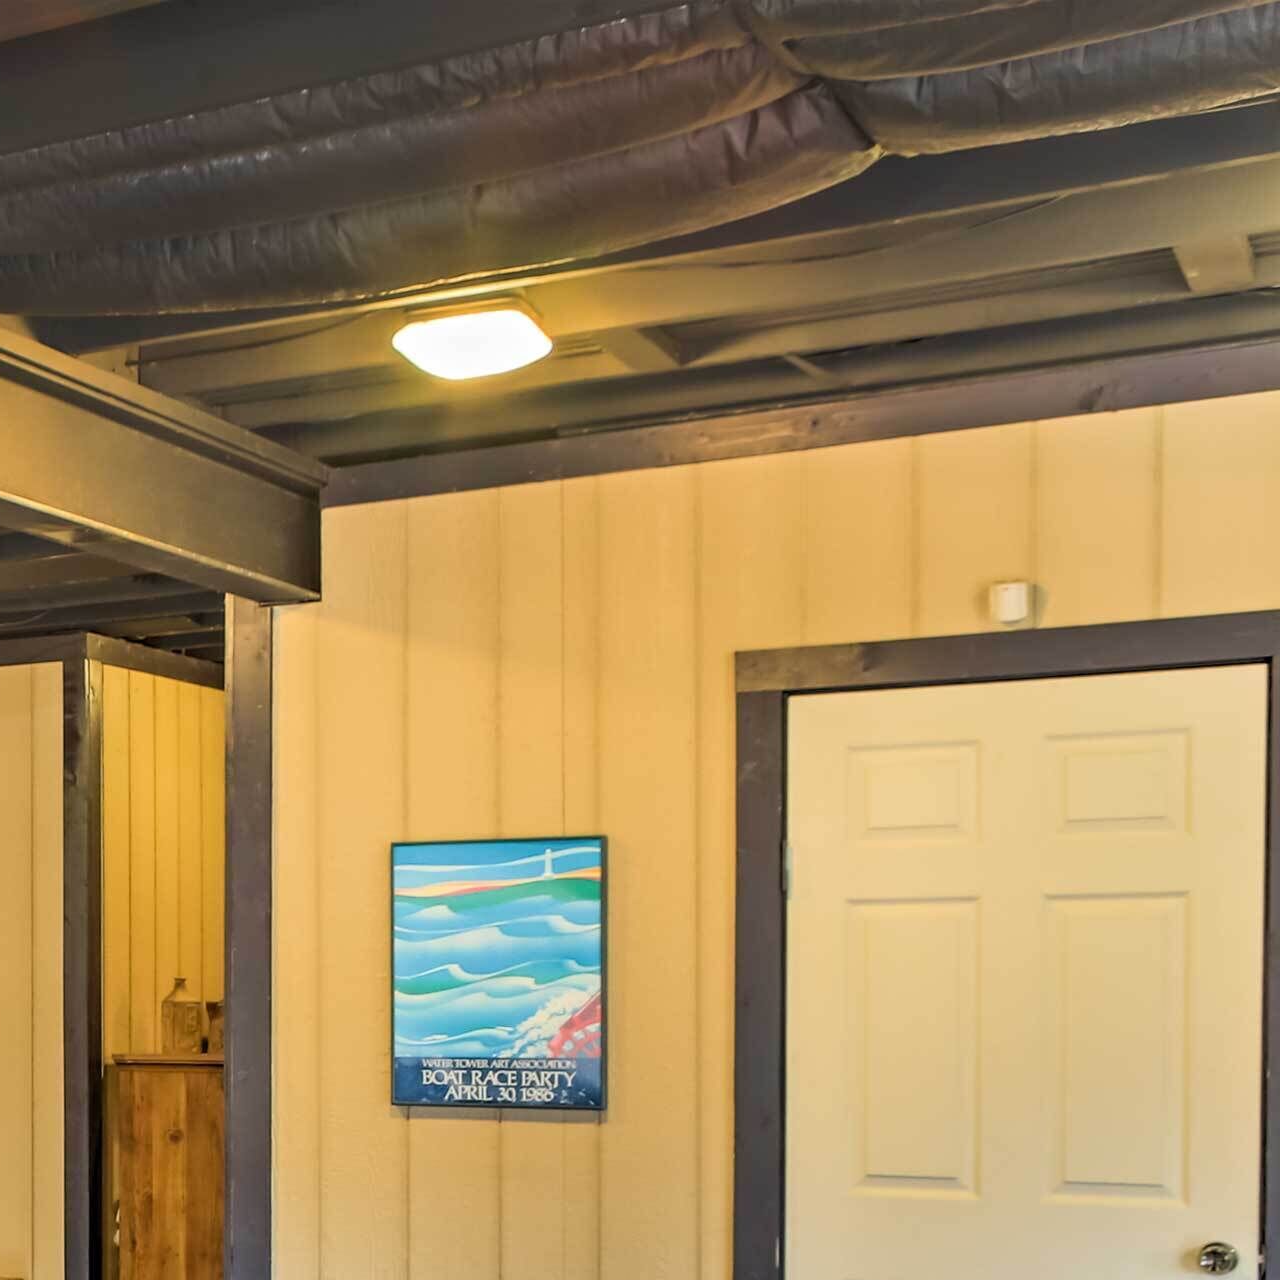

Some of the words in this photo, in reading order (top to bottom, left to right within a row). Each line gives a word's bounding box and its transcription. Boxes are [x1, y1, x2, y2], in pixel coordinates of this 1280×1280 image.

[490, 1059, 510, 1069] ART
[510, 1060, 576, 1069] ASSOCIATION
[422, 1069, 467, 1085] BOAT
[471, 1070, 517, 1086] RACE
[521, 1071, 577, 1090] PARTY
[444, 1085, 492, 1101] APRIL
